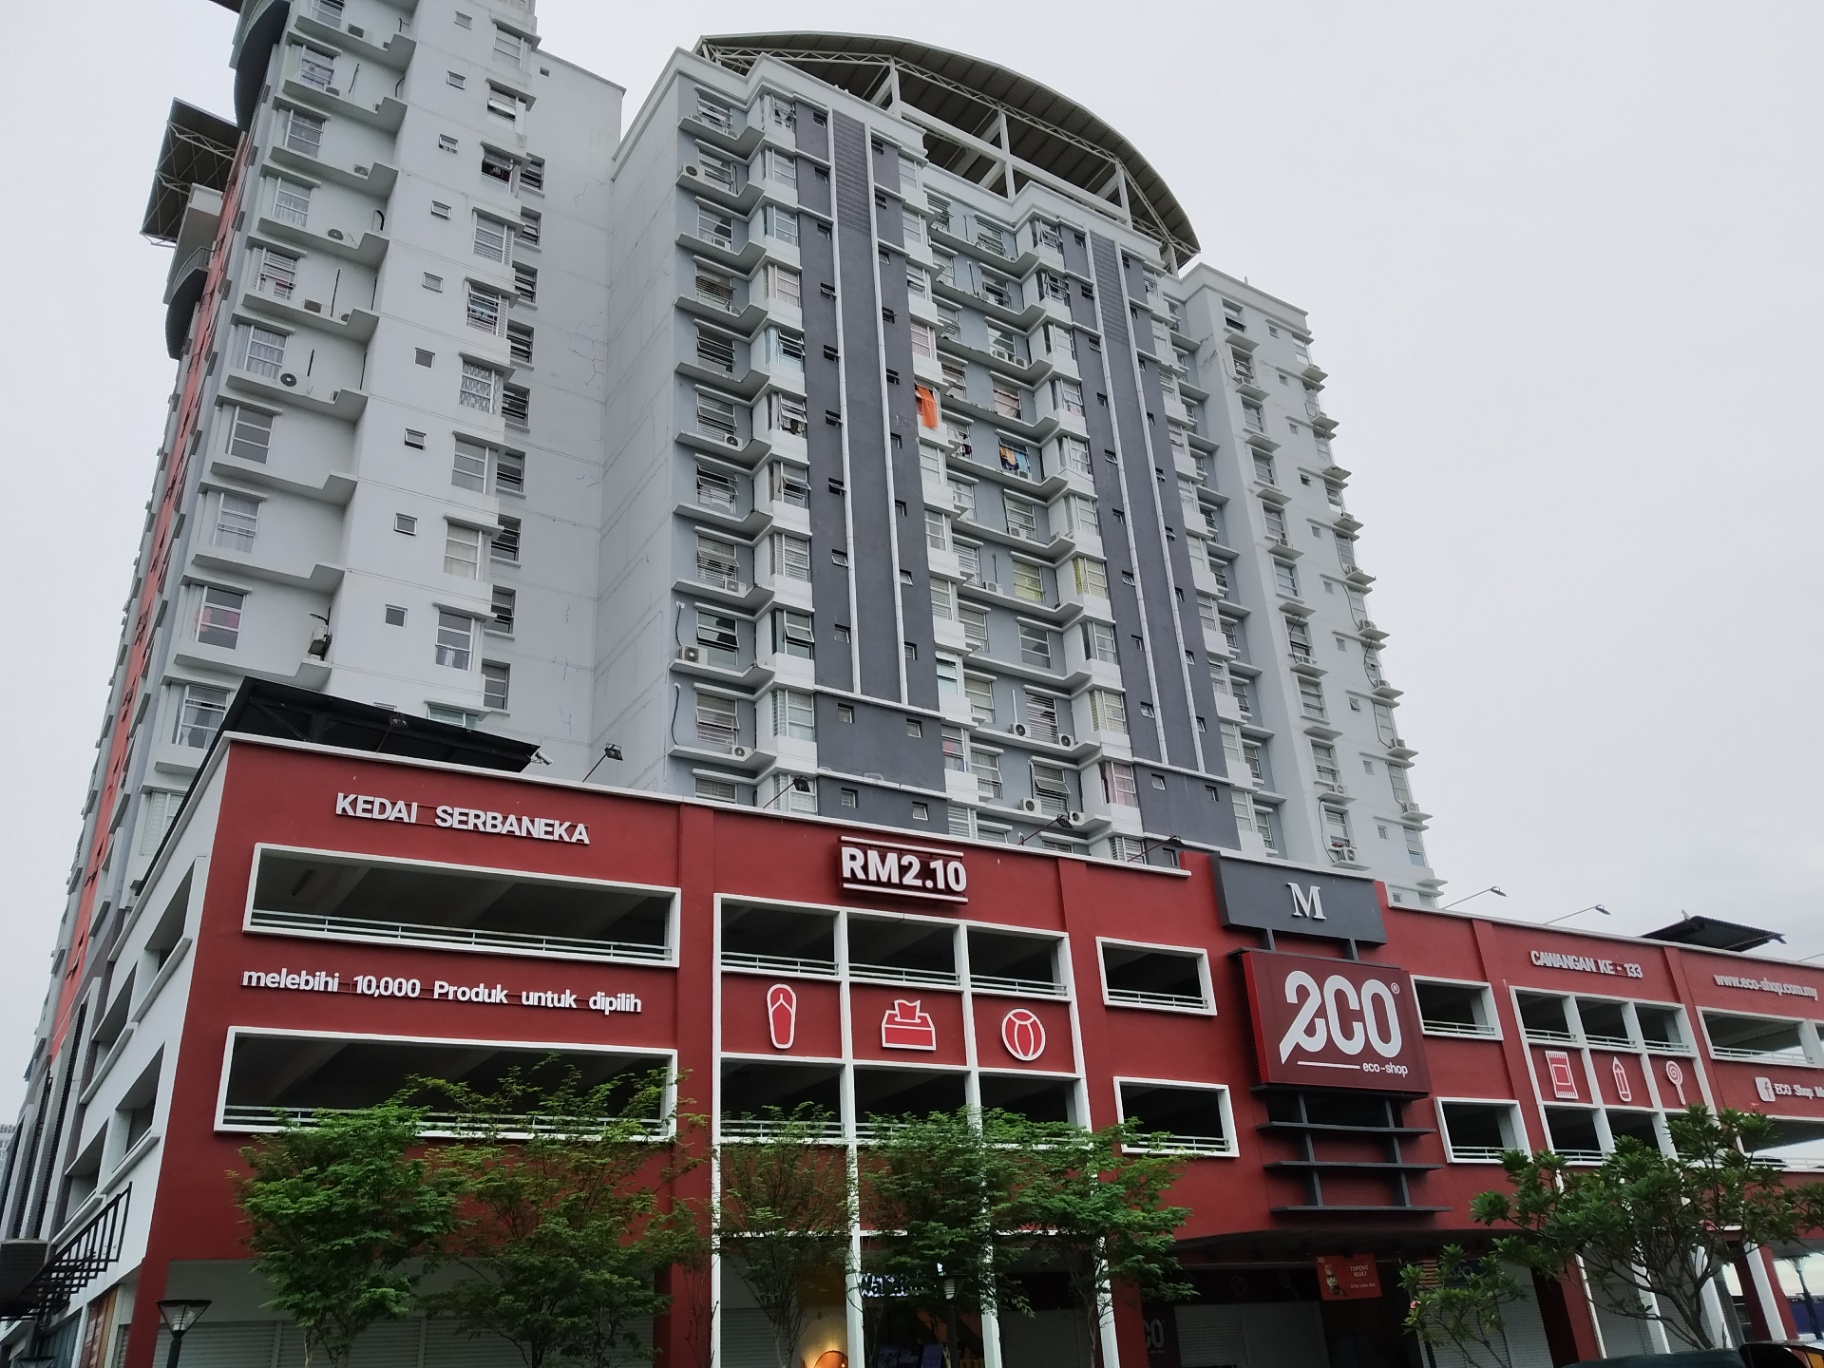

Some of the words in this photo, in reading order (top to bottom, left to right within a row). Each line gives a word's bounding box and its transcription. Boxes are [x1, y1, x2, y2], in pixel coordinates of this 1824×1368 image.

[335, 792, 418, 824] KEDAI
[434, 805, 591, 845] SERBANEKA
[841, 846, 967, 892] RM2.10
[1286, 881, 1327, 920] M
[1530, 950, 1596, 973] CAWANGAN
[1598, 959, 1616, 975] KE
[1623, 963, 1643, 978] 133
[242, 968, 340, 992] melebihi
[352, 975, 421, 998] 10,000
[433, 980, 509, 1004] Produk
[521, 988, 578, 1009] untuk
[588, 991, 642, 1016] dipilih
[1713, 974, 1819, 1001] www.eco-shop.com.my
[1362, 1061, 1409, 1078] eco-shop
[1774, 1083, 1792, 1096] ECO
[1793, 1084, 1814, 1100] Shop
